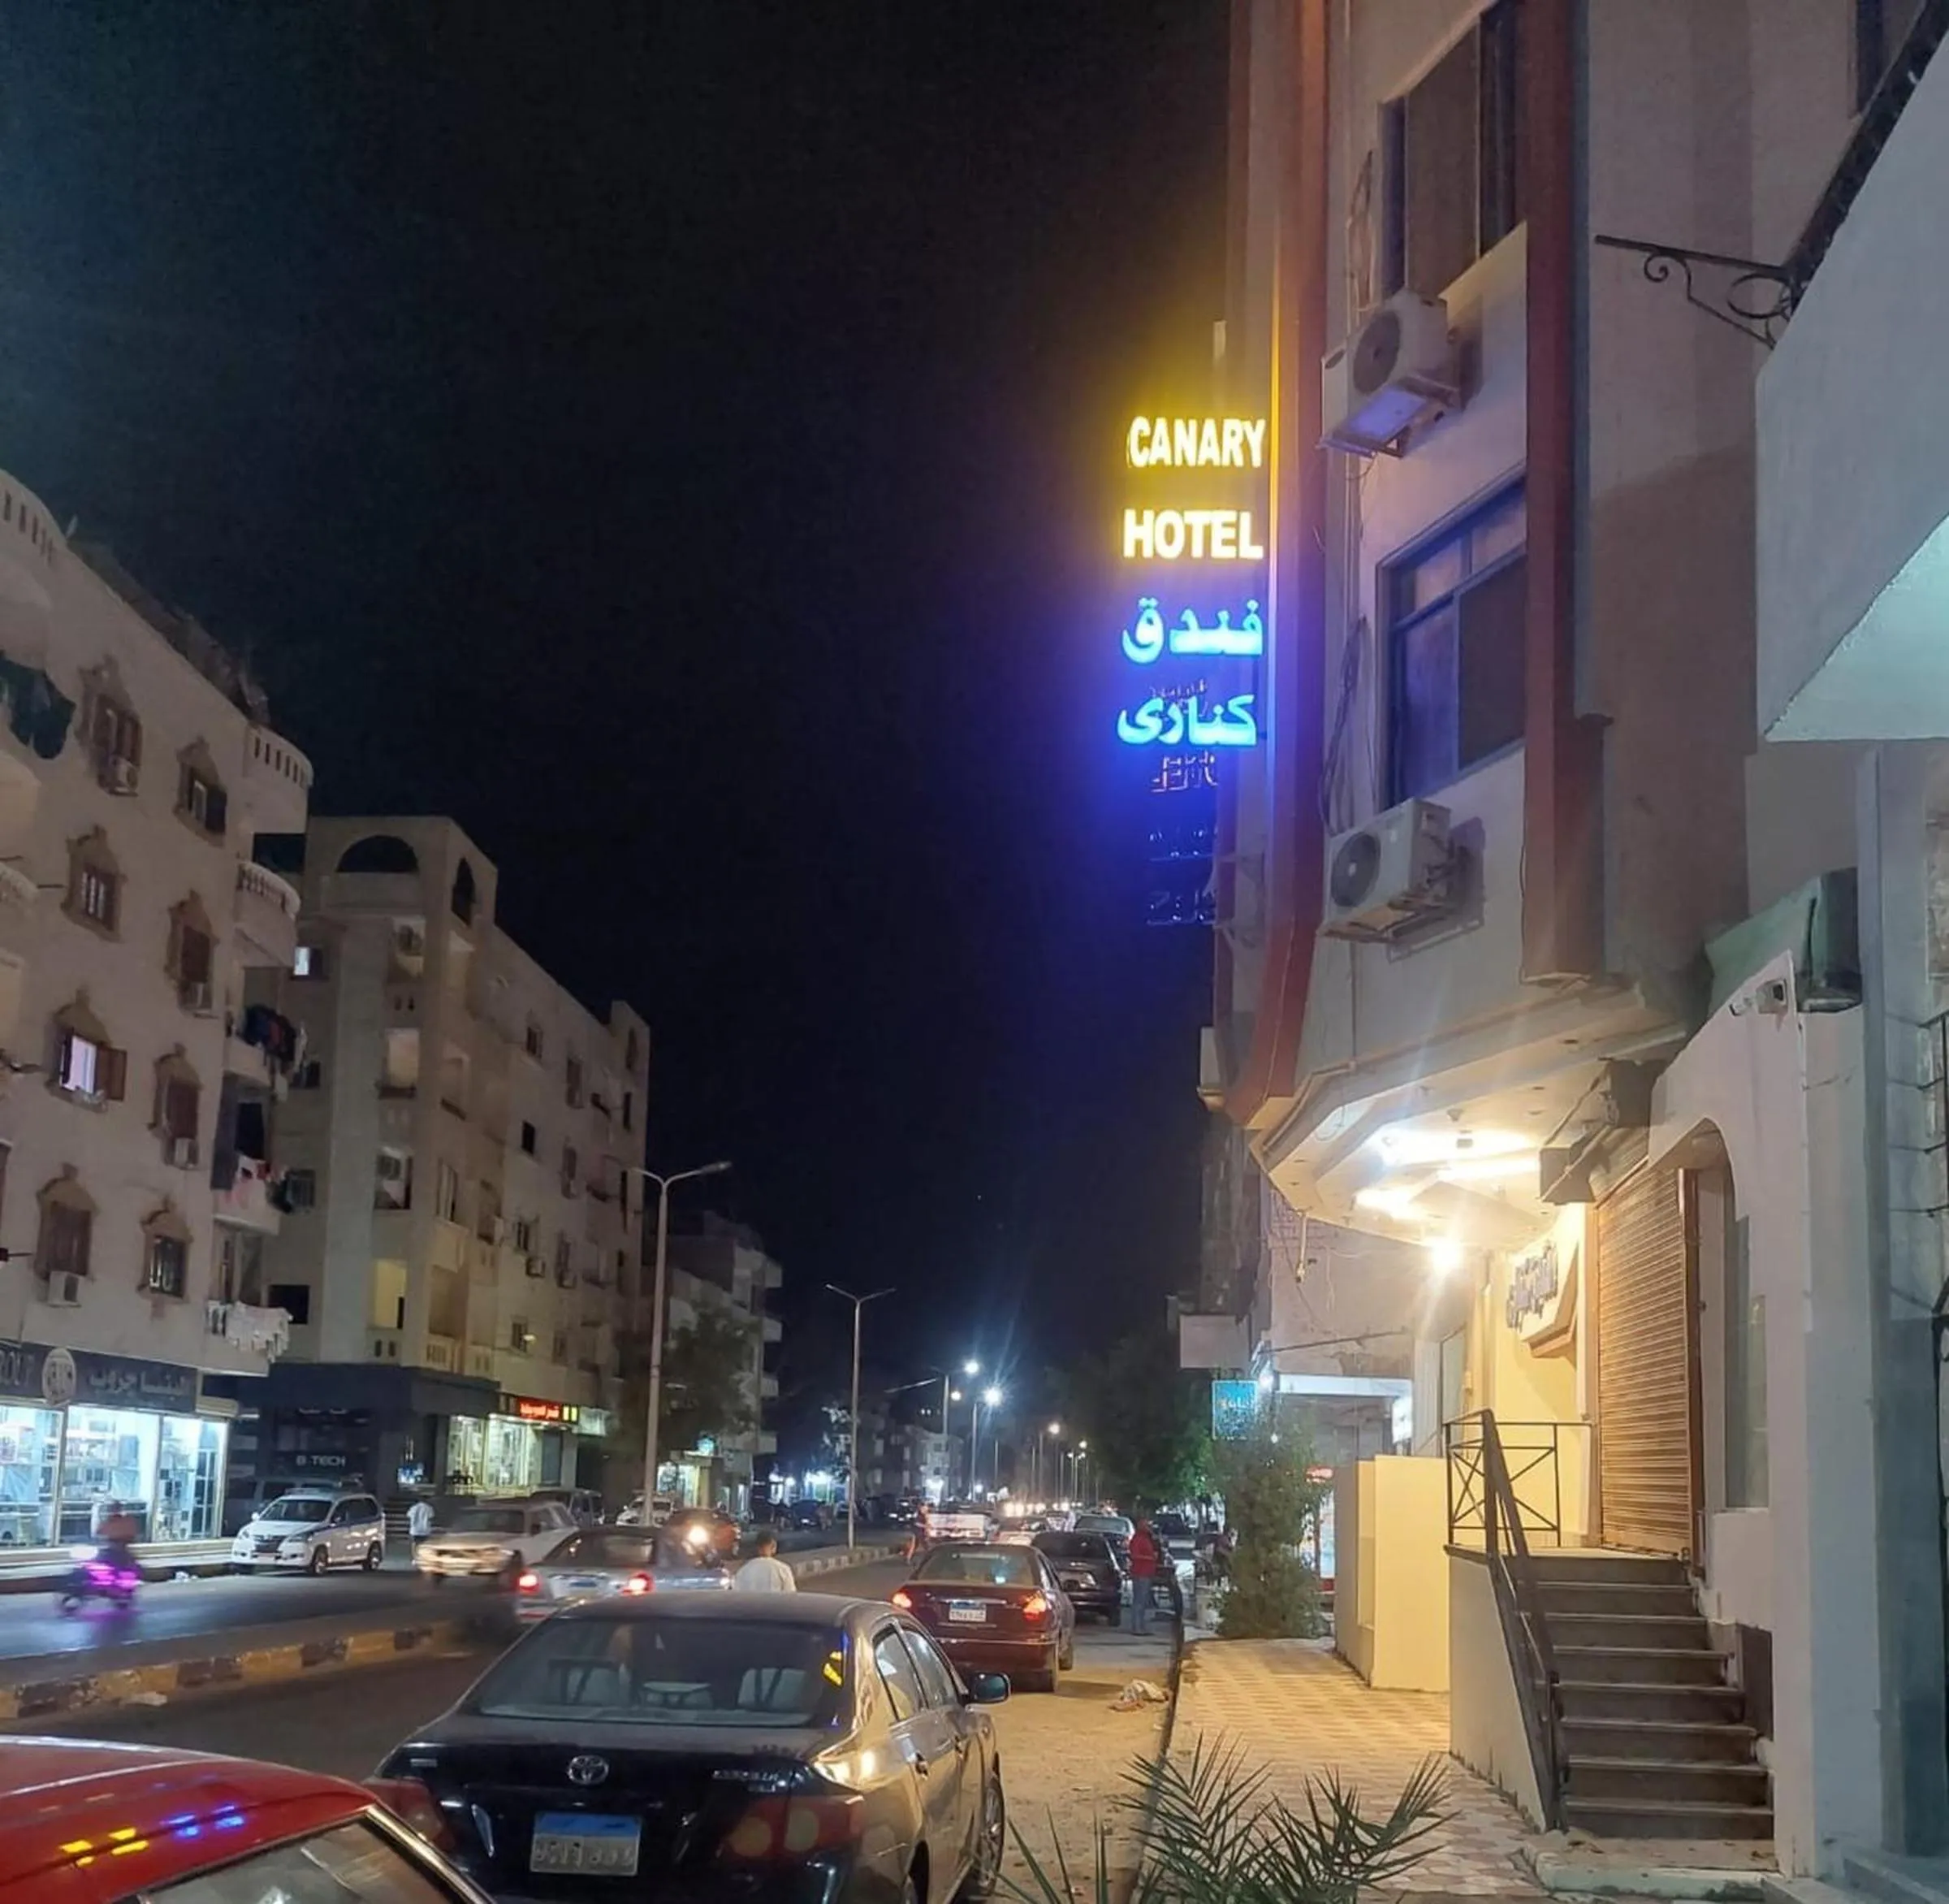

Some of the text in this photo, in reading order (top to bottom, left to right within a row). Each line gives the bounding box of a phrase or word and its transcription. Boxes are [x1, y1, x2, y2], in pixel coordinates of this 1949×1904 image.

[1128, 416, 1266, 468] CANARY
[1123, 508, 1264, 560] HOTEL
[1121, 596, 1264, 664] فندق
